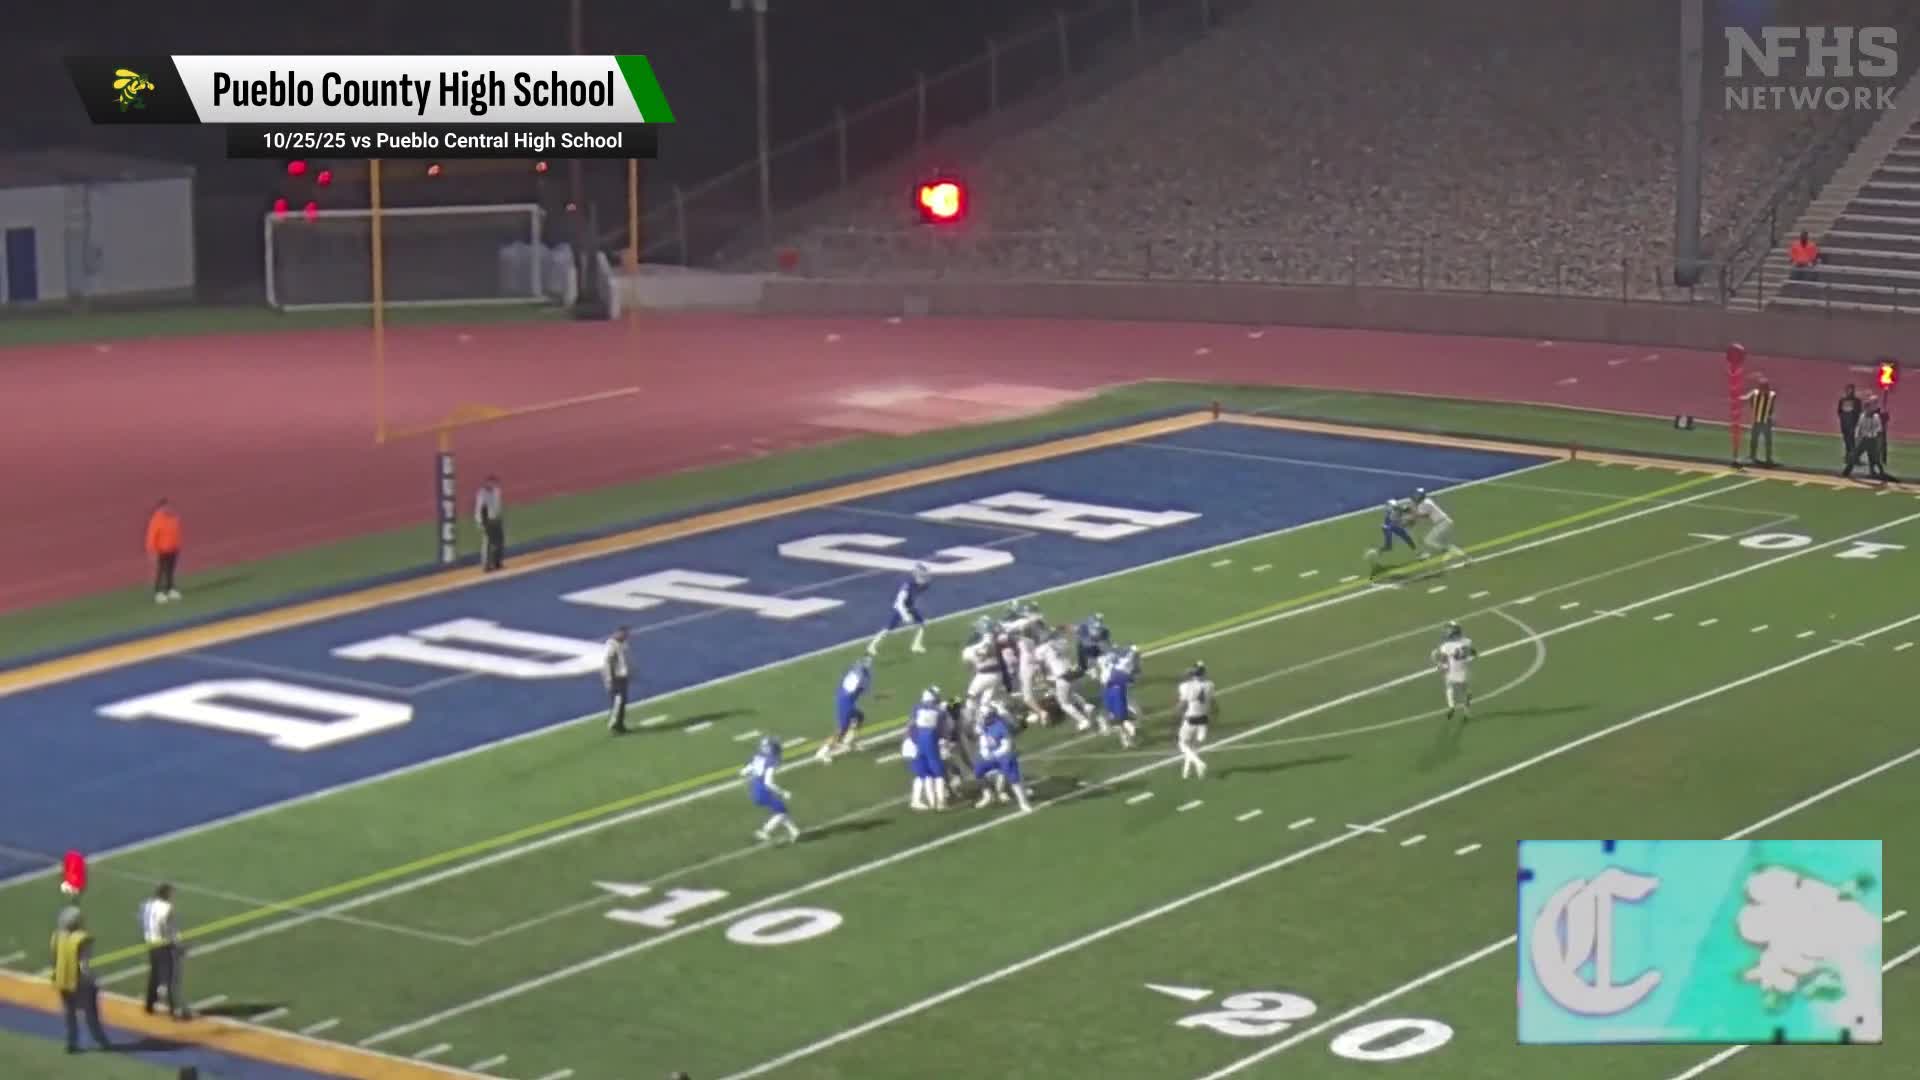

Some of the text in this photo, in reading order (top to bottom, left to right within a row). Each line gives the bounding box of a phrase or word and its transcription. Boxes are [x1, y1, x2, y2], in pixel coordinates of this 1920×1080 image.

[97, 490, 1202, 751] DUTCH
[603, 887, 844, 945] 10
[1173, 990, 1455, 1062] 20
